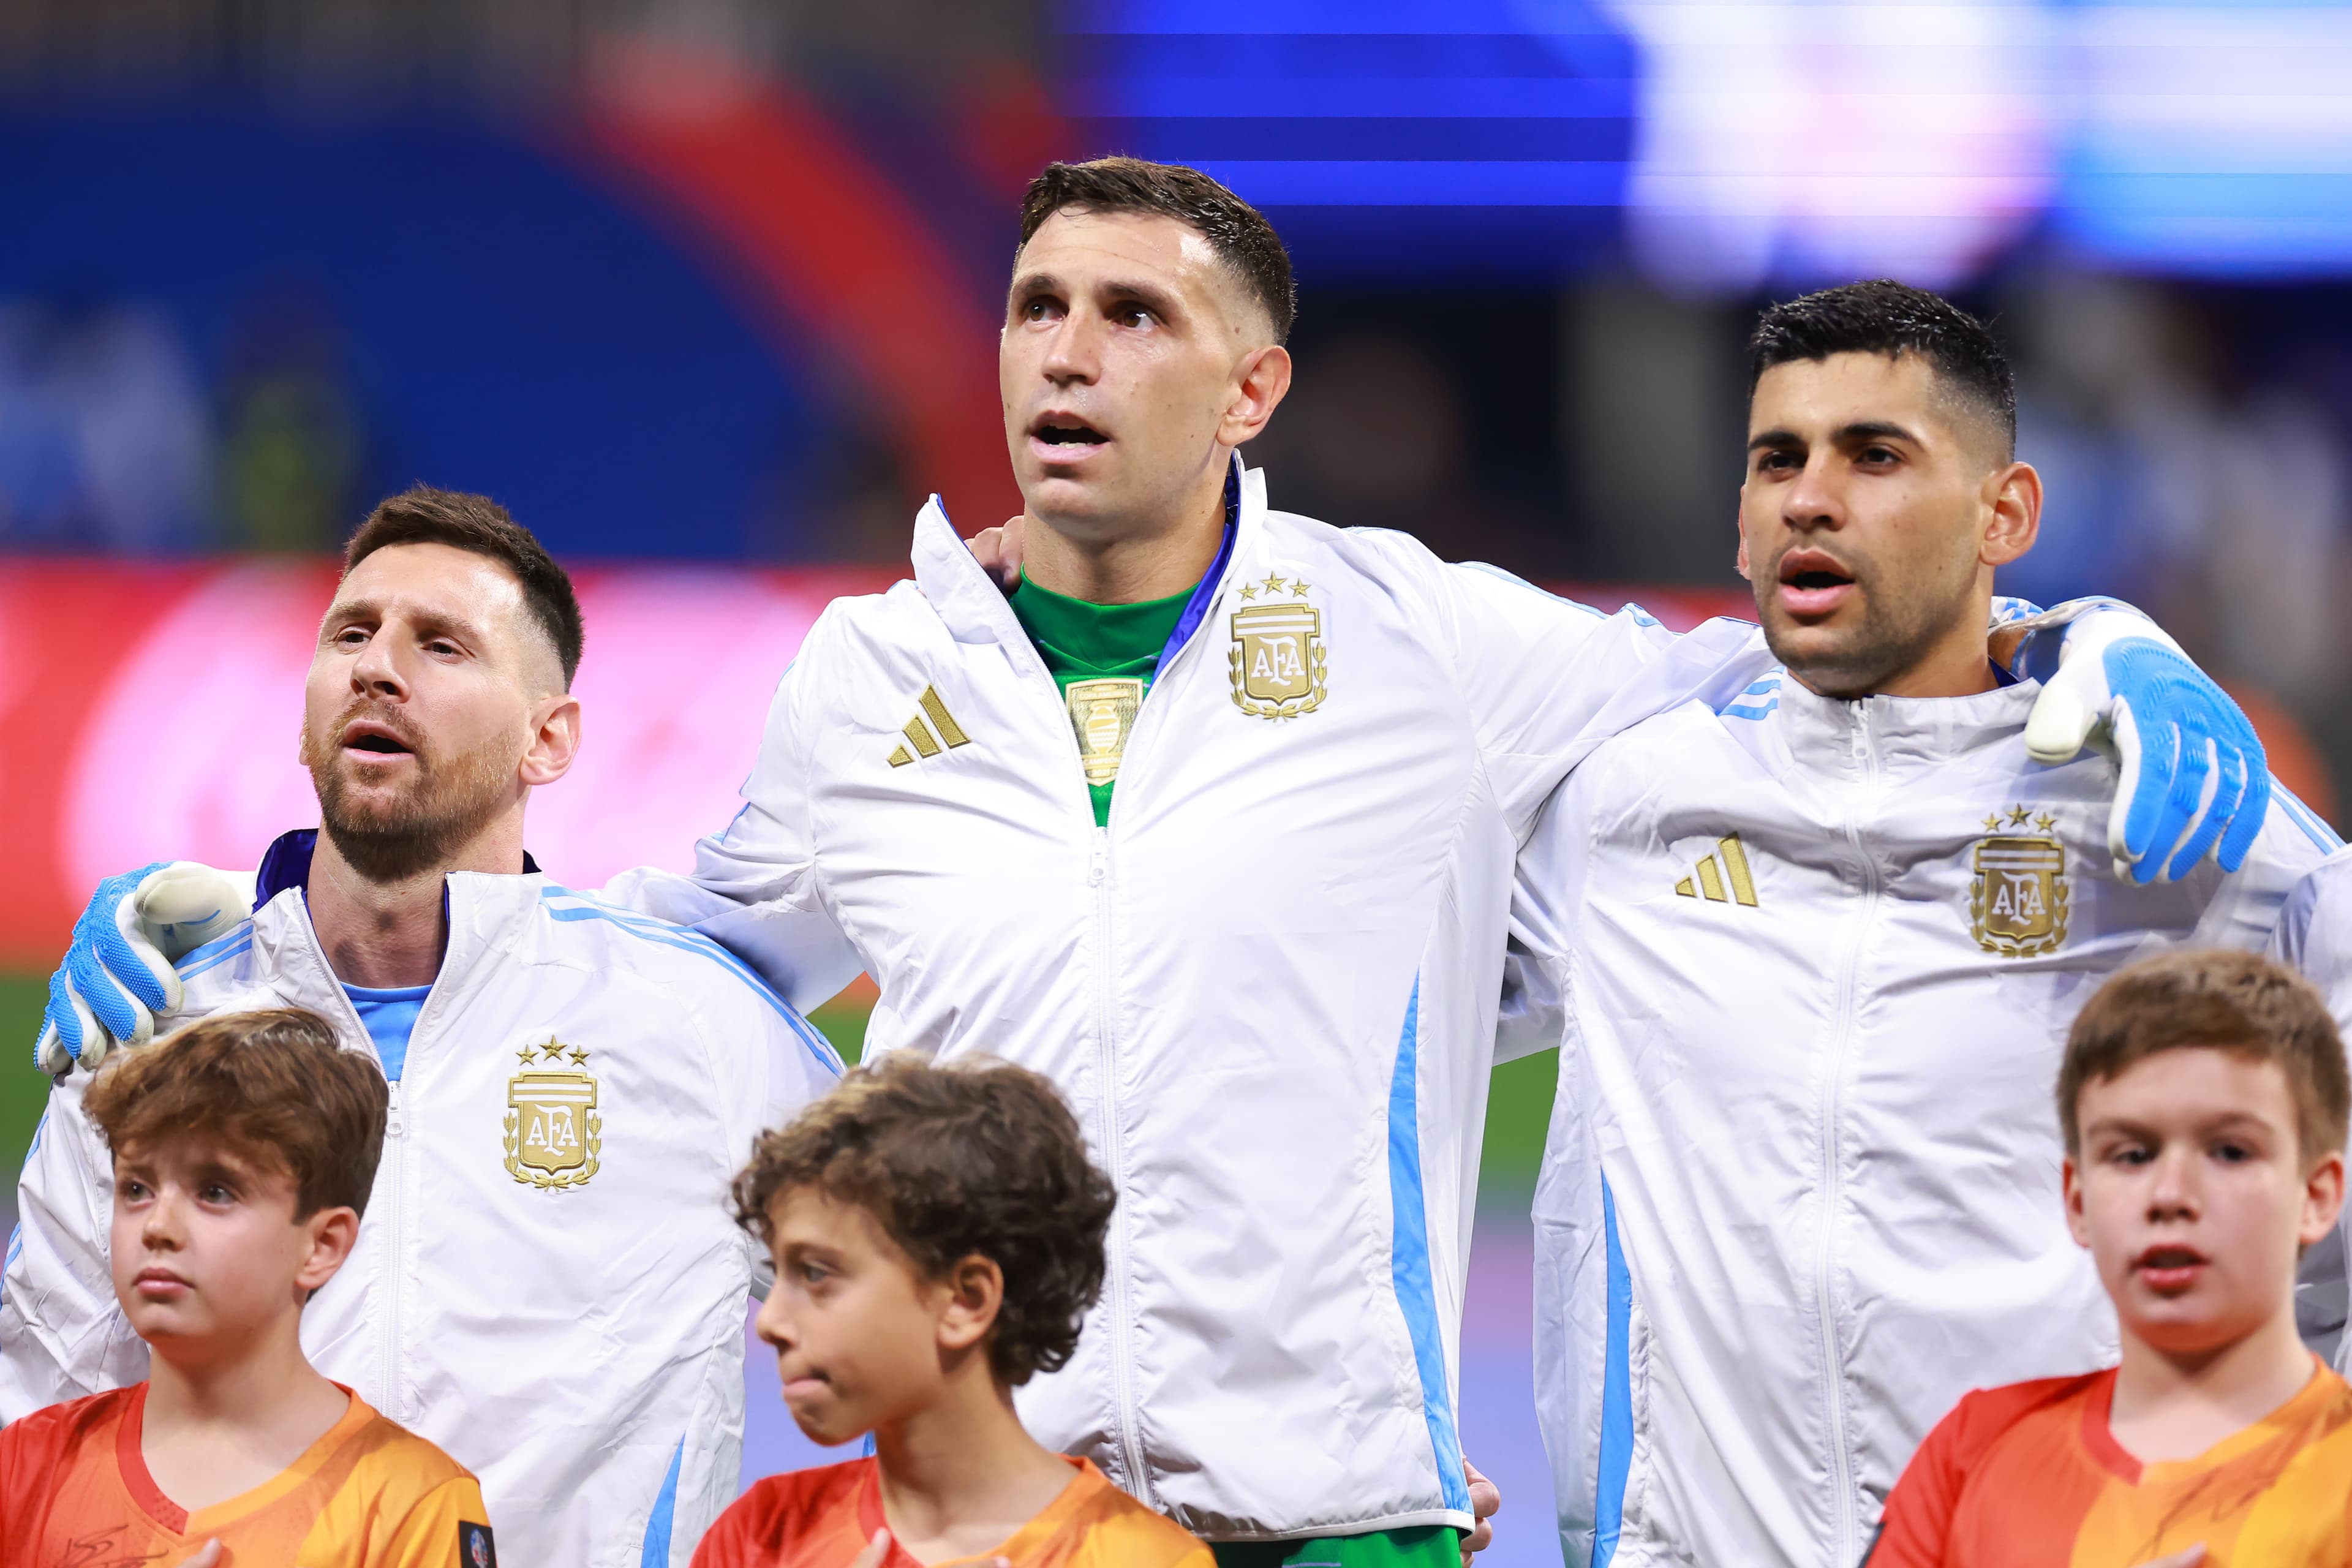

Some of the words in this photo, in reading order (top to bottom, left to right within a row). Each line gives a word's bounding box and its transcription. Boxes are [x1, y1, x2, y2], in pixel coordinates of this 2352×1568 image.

[1251, 635, 1305, 687] AFA
[1991, 871, 2047, 926] AFA
[526, 1103, 579, 1157] AFA
